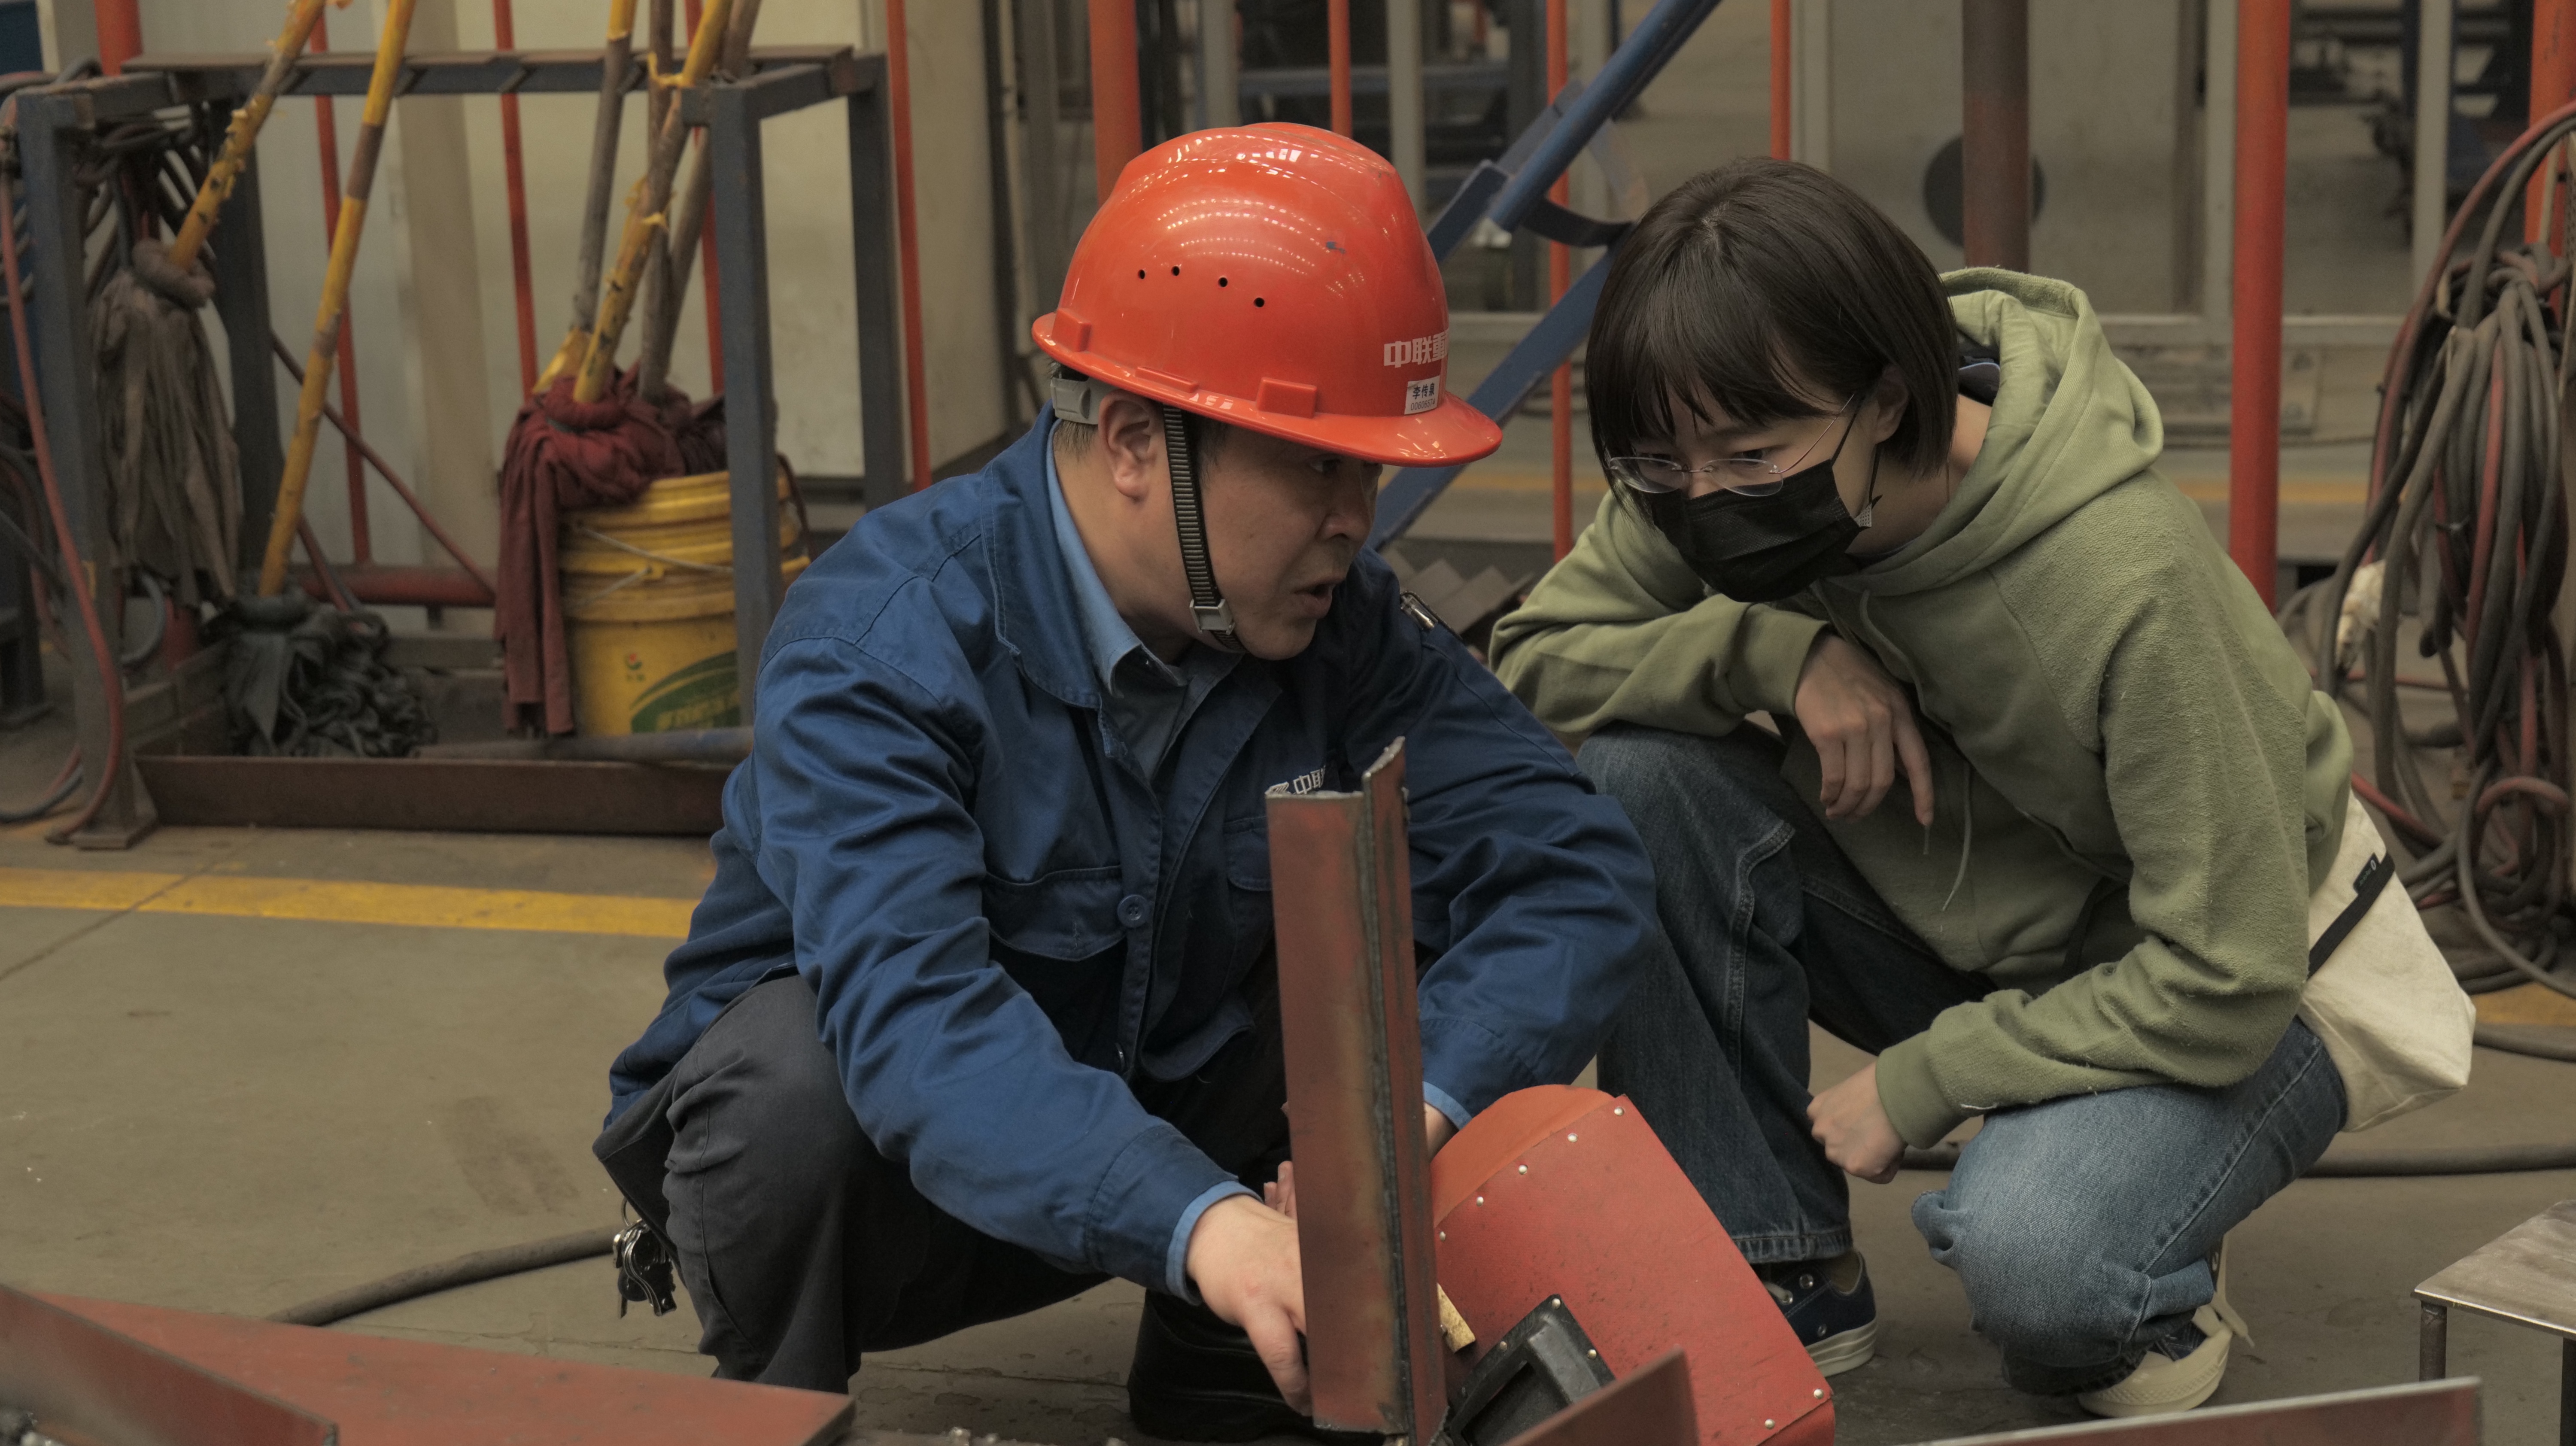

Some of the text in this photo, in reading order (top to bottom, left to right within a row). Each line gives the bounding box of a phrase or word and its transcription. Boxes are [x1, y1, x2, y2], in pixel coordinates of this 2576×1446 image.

[1384, 329, 1448, 368] 中联重
[1413, 383, 1435, 400] 李传泉
